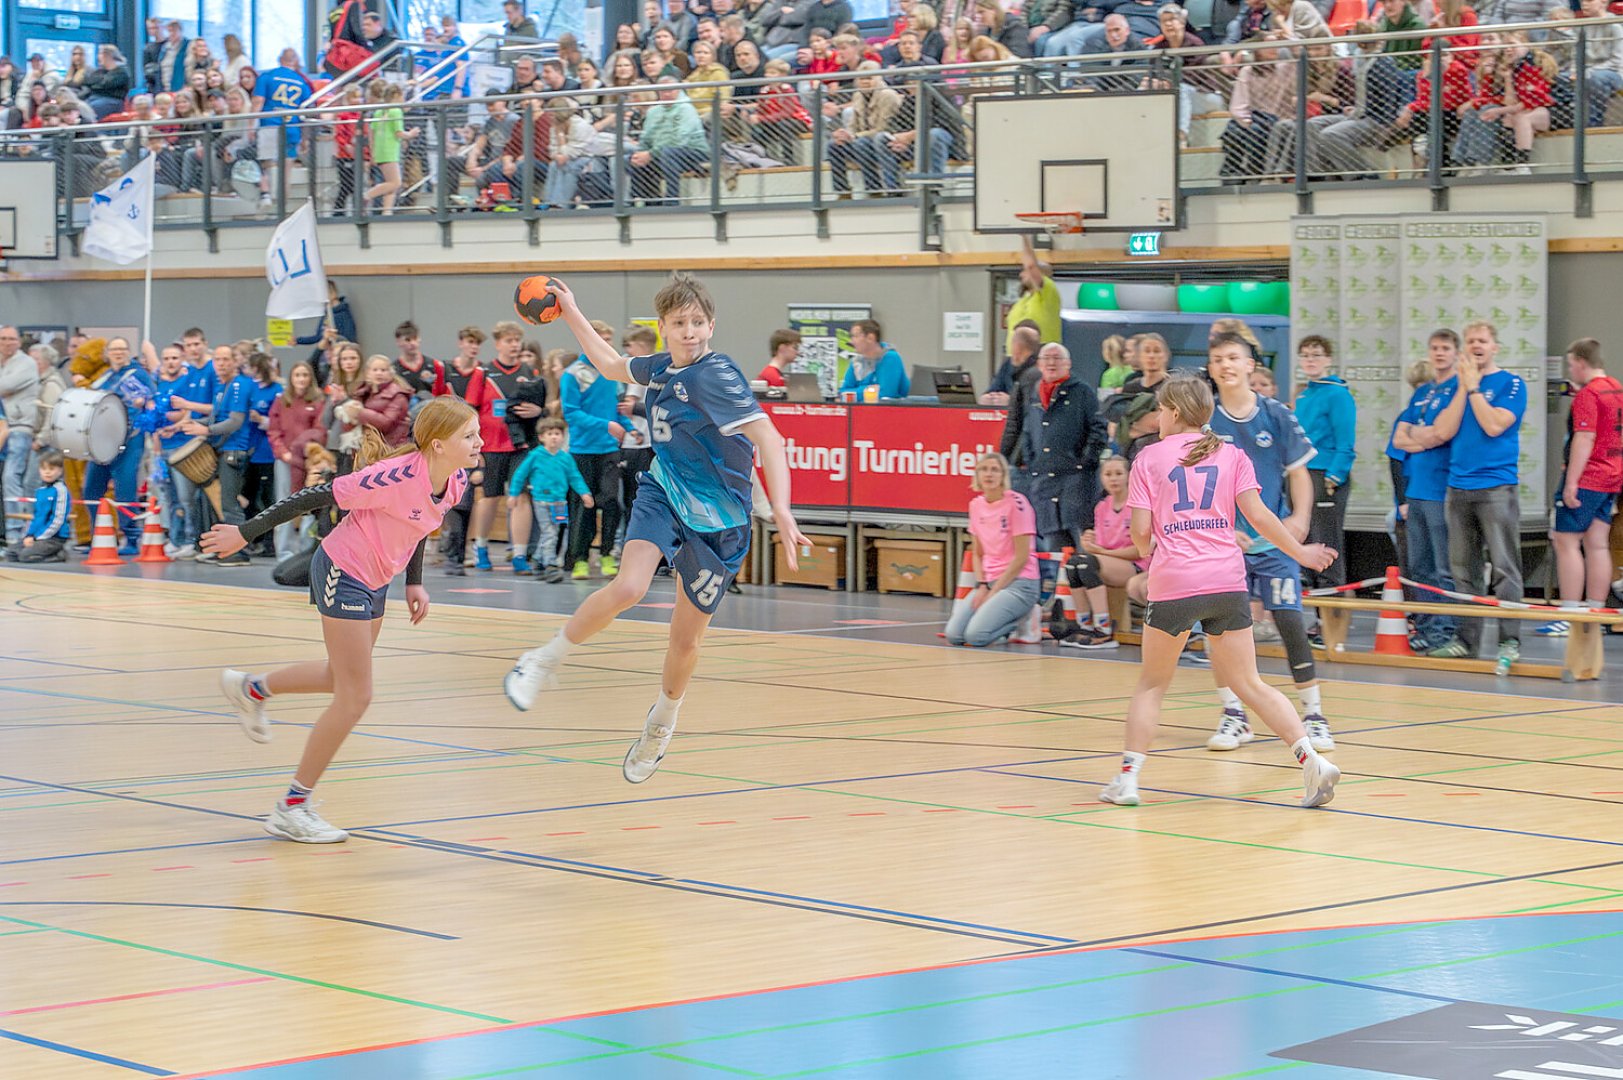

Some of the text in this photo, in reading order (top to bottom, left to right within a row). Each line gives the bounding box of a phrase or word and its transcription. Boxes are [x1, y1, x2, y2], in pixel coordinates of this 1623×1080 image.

[272, 83, 303, 107] 42
[853, 440, 994, 476] Turnierlei
[1168, 465, 1219, 512] 17
[690, 568, 724, 607] 15
[1270, 577, 1297, 605] 14
